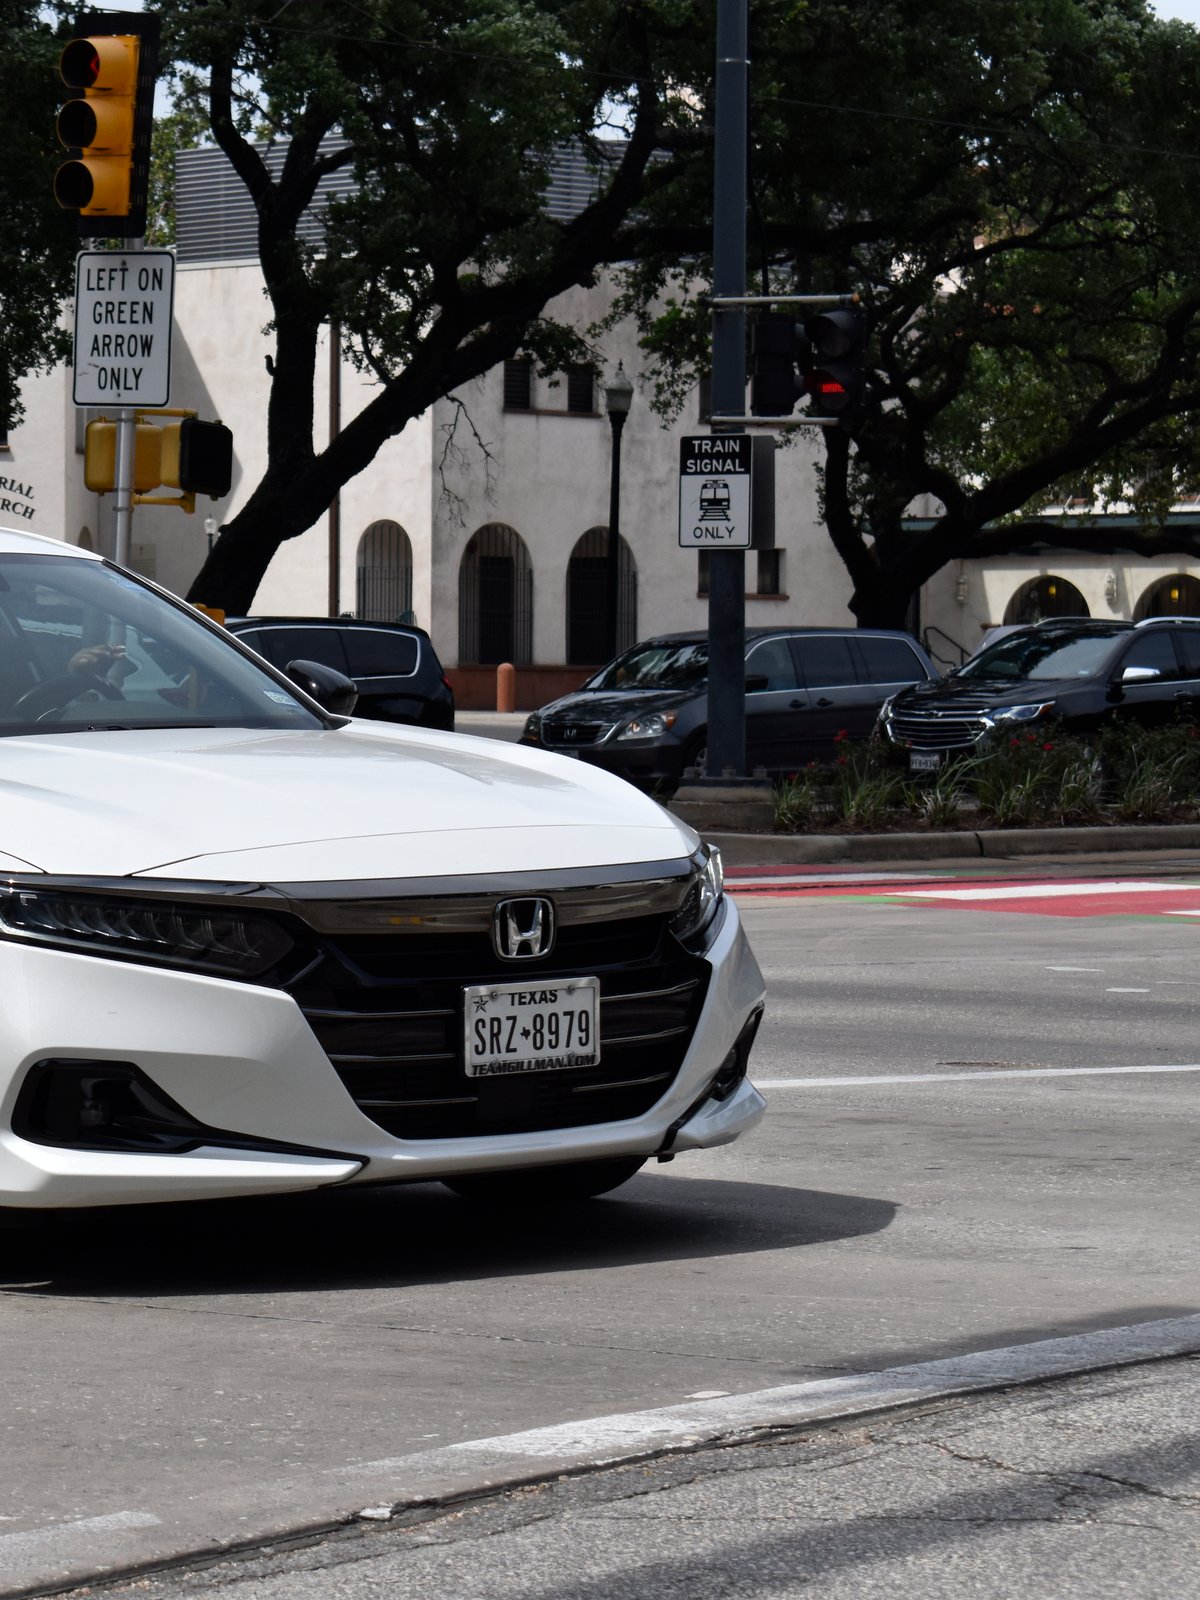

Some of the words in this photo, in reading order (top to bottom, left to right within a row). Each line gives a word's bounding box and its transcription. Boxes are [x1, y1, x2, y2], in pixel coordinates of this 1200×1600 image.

[86, 267, 129, 292] LEFT
[138, 267, 163, 292] ON
[92, 301, 154, 325] GREEN
[90, 334, 154, 358] ARROW
[97, 366, 143, 391] ONLY
[692, 440, 740, 454] TRAIN
[686, 459, 745, 473] SIGNAL
[693, 526, 736, 539] ONLY
[508, 989, 558, 1007] TEXAS
